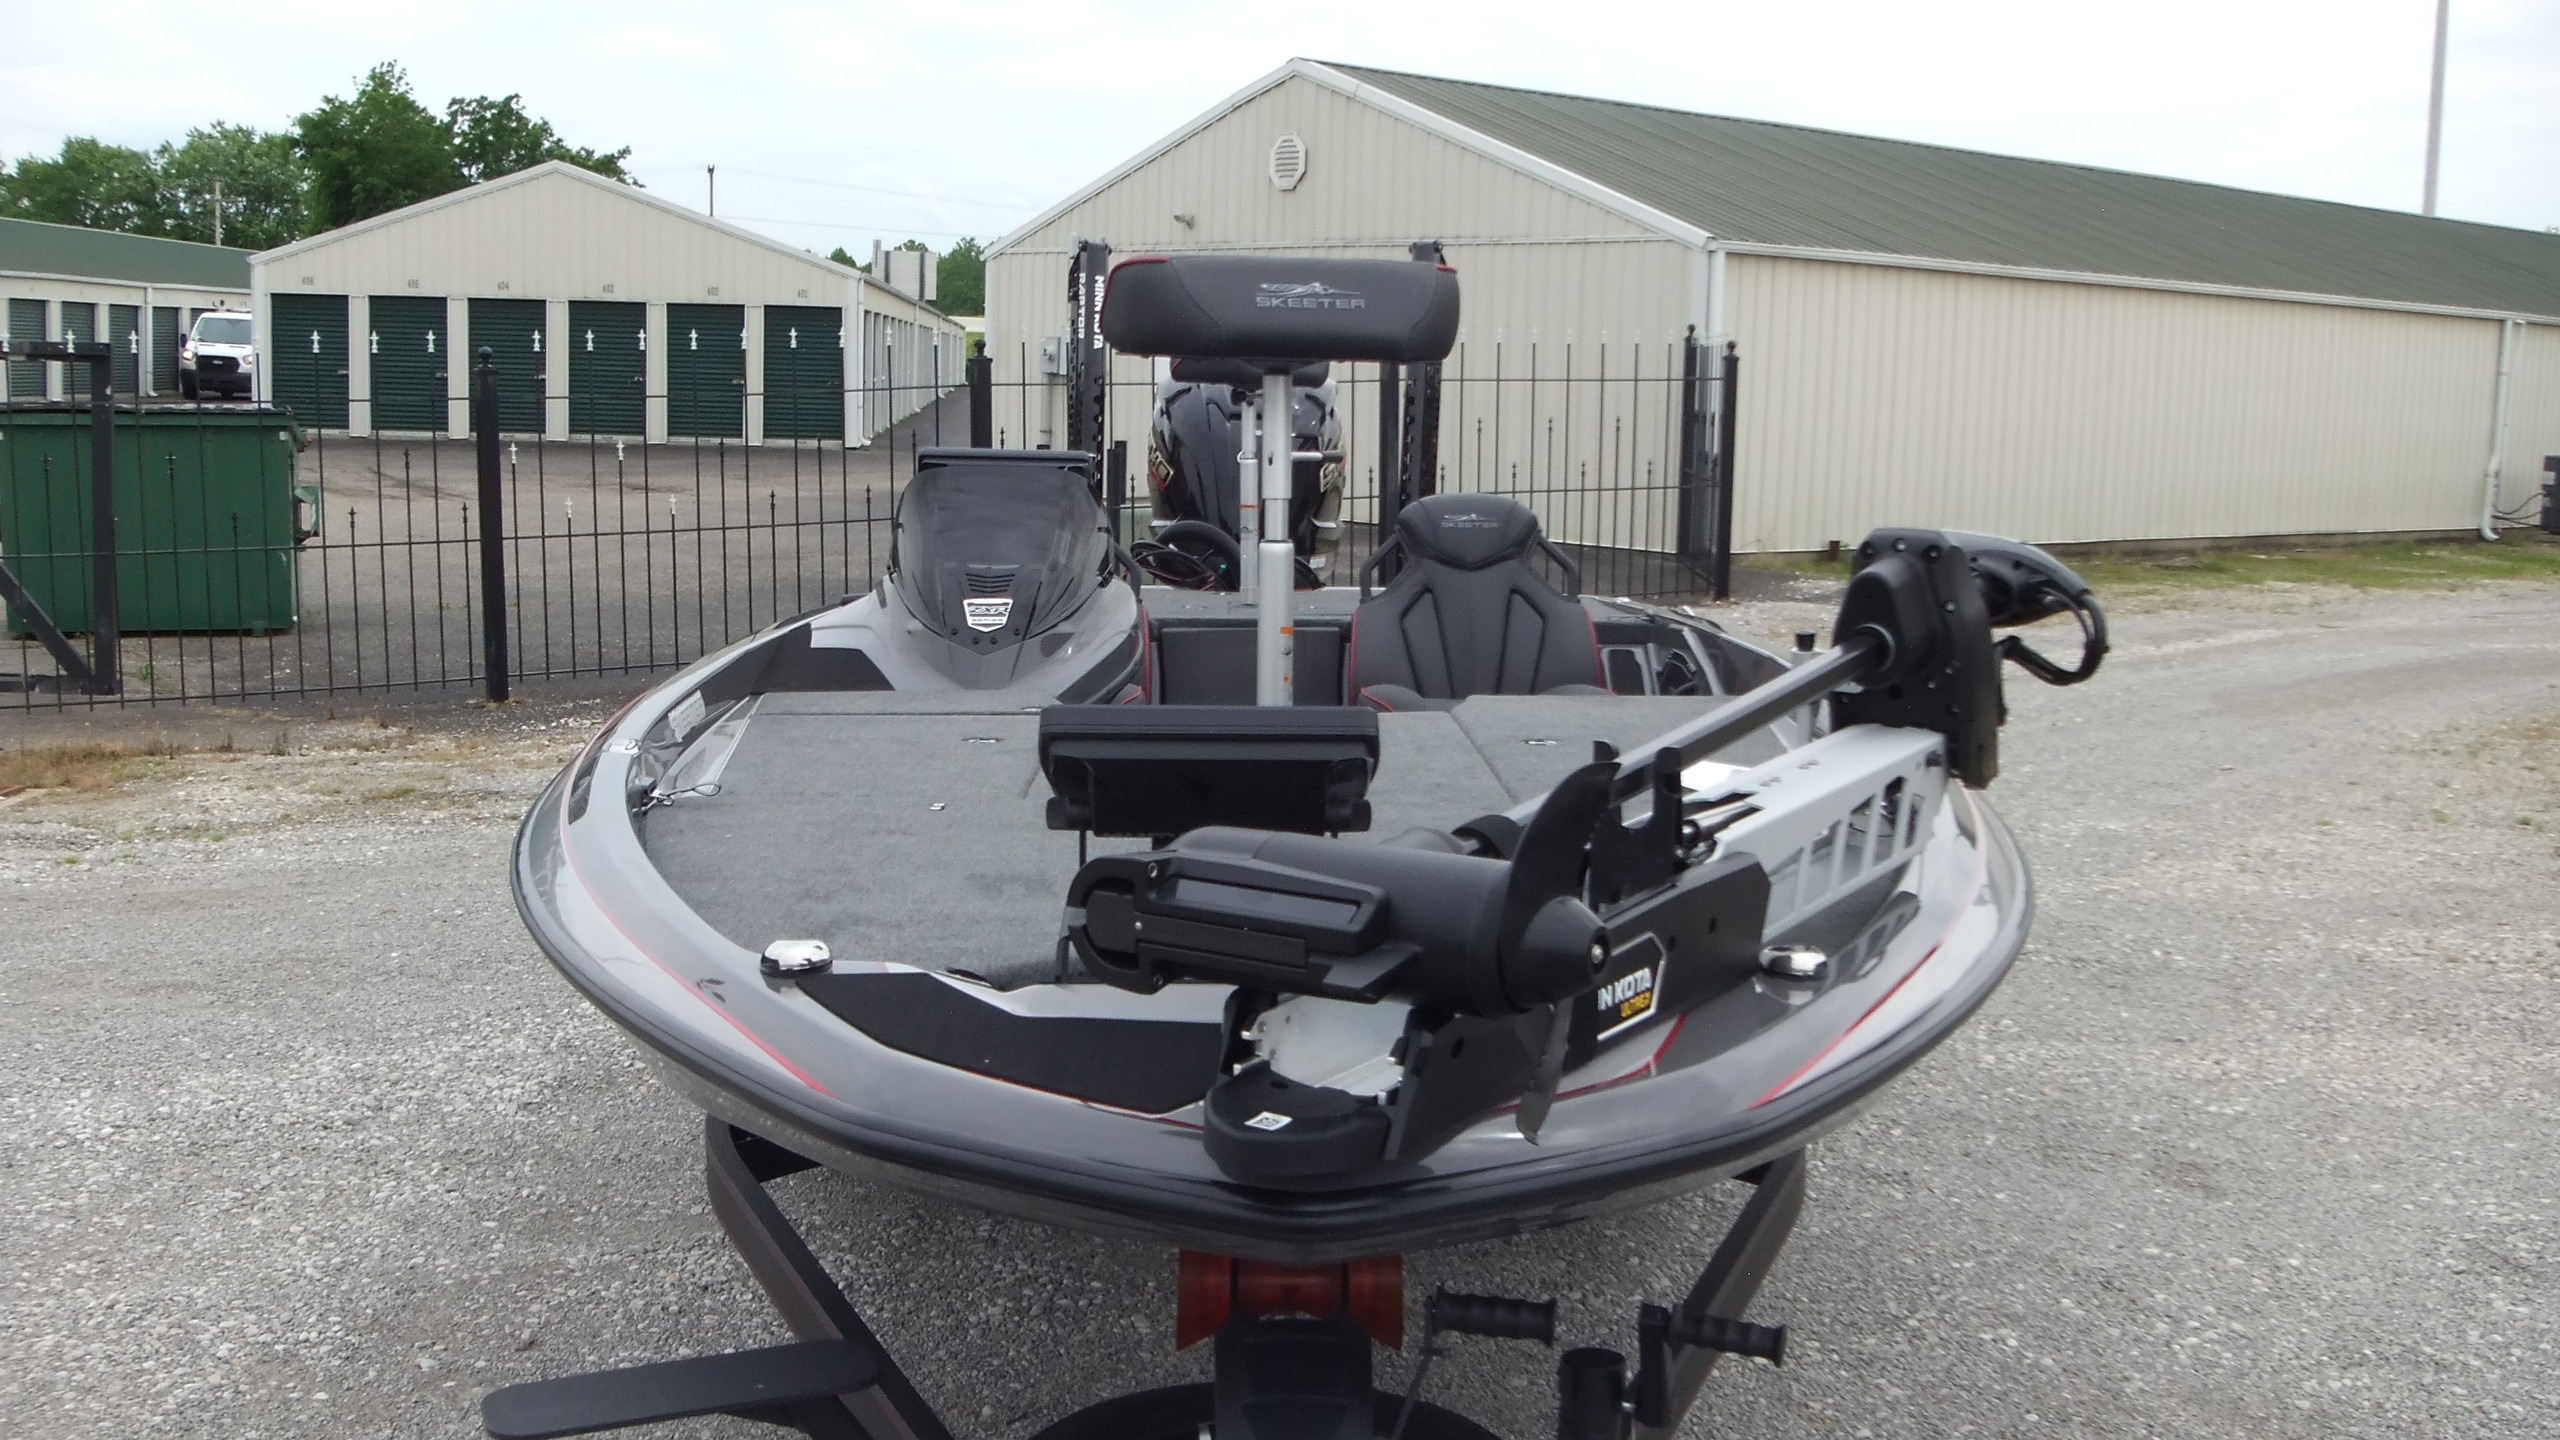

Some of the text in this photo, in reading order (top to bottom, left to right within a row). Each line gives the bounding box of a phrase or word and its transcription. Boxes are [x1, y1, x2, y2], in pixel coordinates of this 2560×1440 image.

[302, 276, 314, 286] 406
[407, 279, 419, 289] 405
[497, 281, 509, 291] 404
[602, 284, 614, 294] 403
[707, 287, 719, 296] 402
[797, 289, 808, 298] 401
[1095, 275, 1105, 311] MINN
[1078, 272, 1086, 339] RAPTOR
[1256, 297, 1366, 310] SKEETER
[1614, 967, 1652, 1004] KOTA
